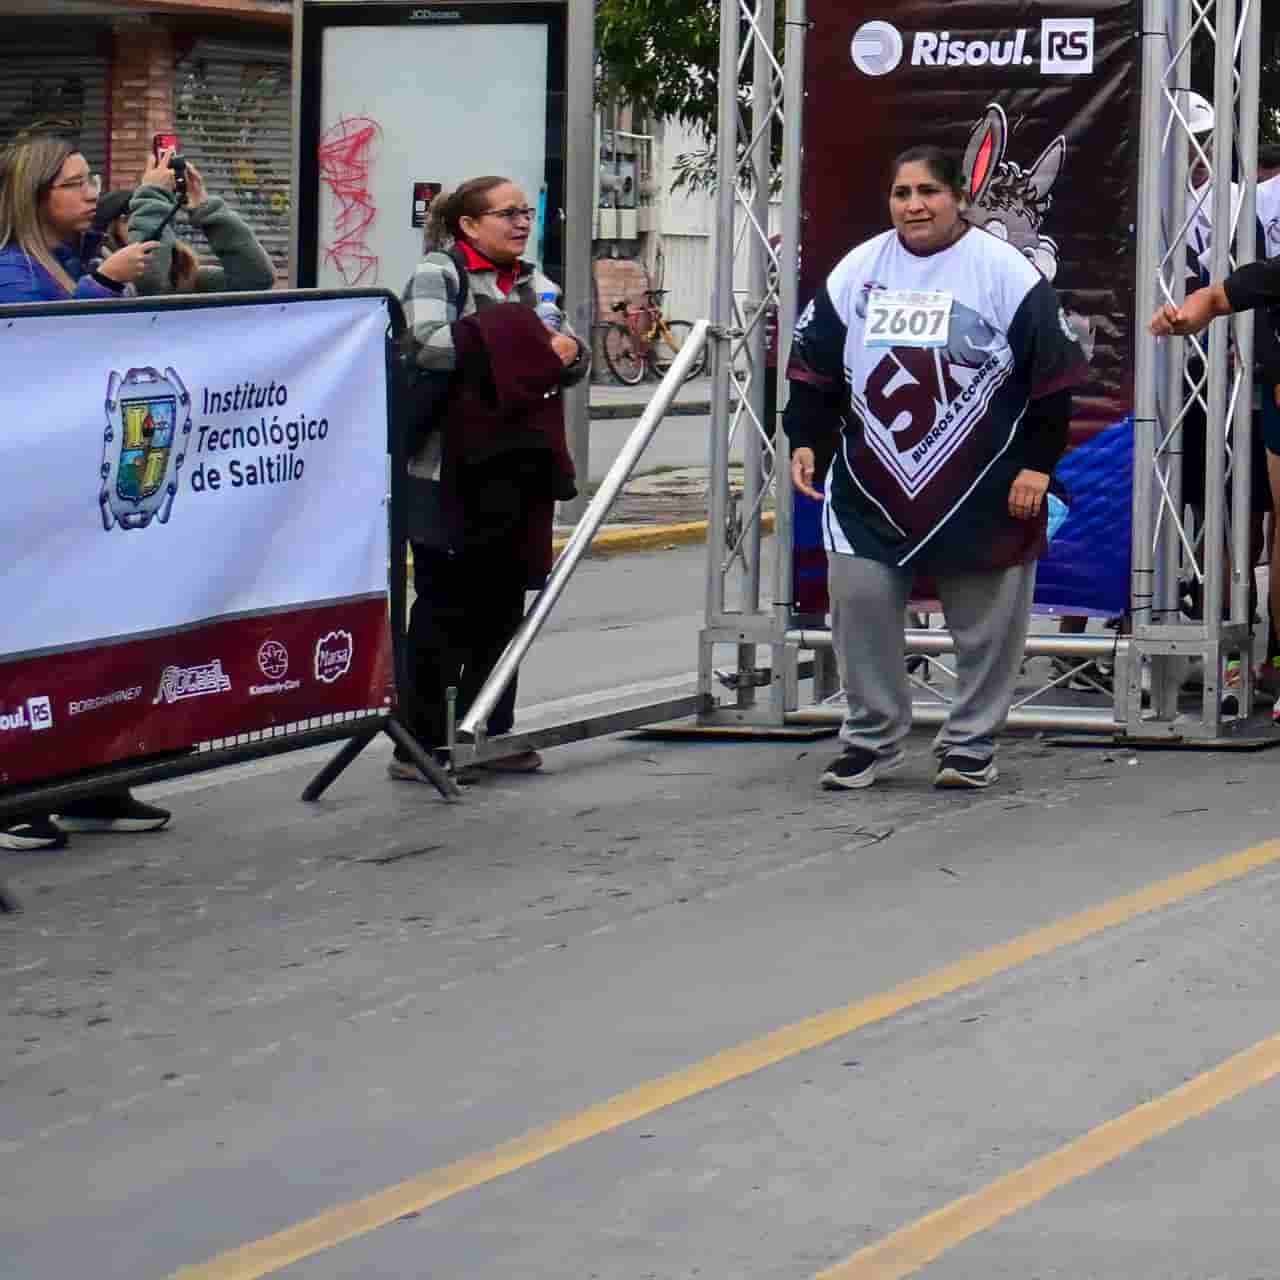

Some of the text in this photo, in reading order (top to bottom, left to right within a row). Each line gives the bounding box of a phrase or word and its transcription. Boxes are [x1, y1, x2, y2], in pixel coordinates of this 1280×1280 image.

[1047, 29, 1089, 61] RS
[870, 308, 945, 336] 2607
[202, 381, 288, 415] Instituto
[197, 415, 328, 453] Tecnológico
[911, 410, 955, 464] BURROS
[191, 452, 304, 492] de Saltillo
